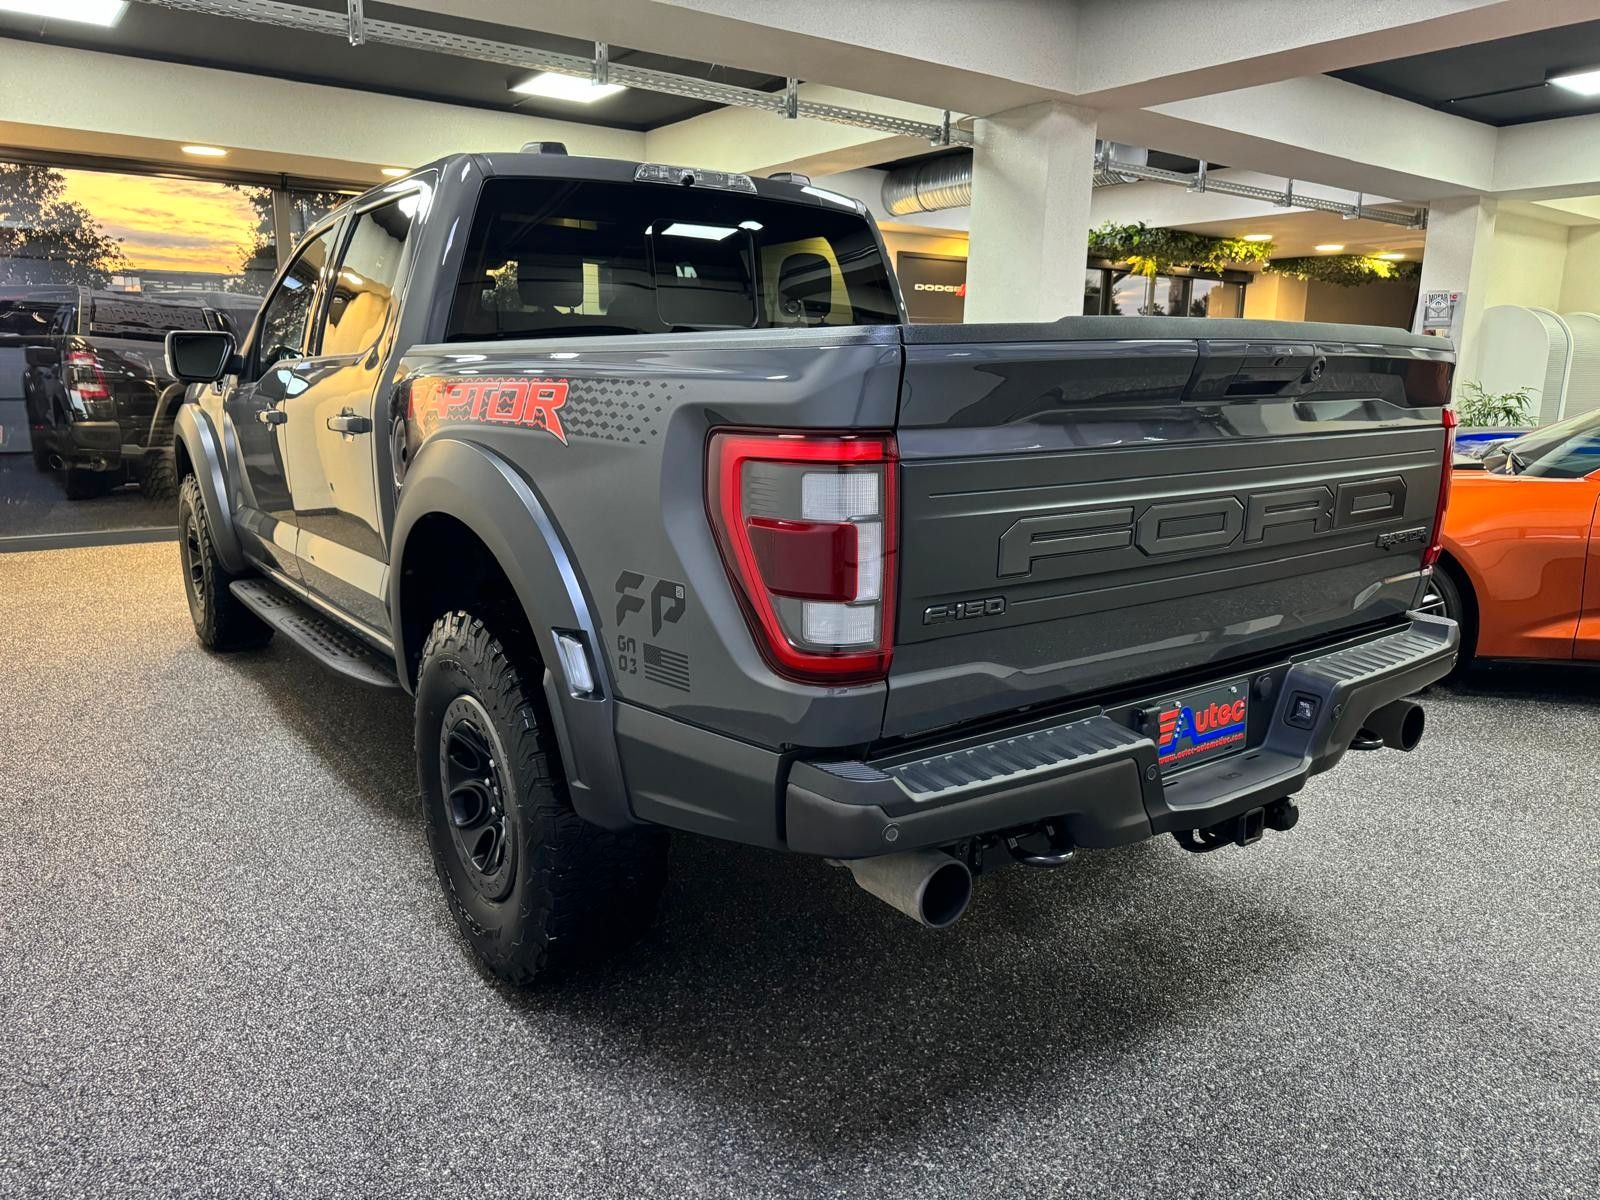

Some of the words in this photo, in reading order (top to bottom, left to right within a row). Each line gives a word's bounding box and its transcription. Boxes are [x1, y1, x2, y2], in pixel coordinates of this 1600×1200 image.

[914, 283, 962, 293] DODGE
[408, 380, 569, 446] RAPTOR
[997, 475, 1408, 579] FORD
[922, 597, 1006, 625] F-150
[1174, 699, 1246, 745] Autec
